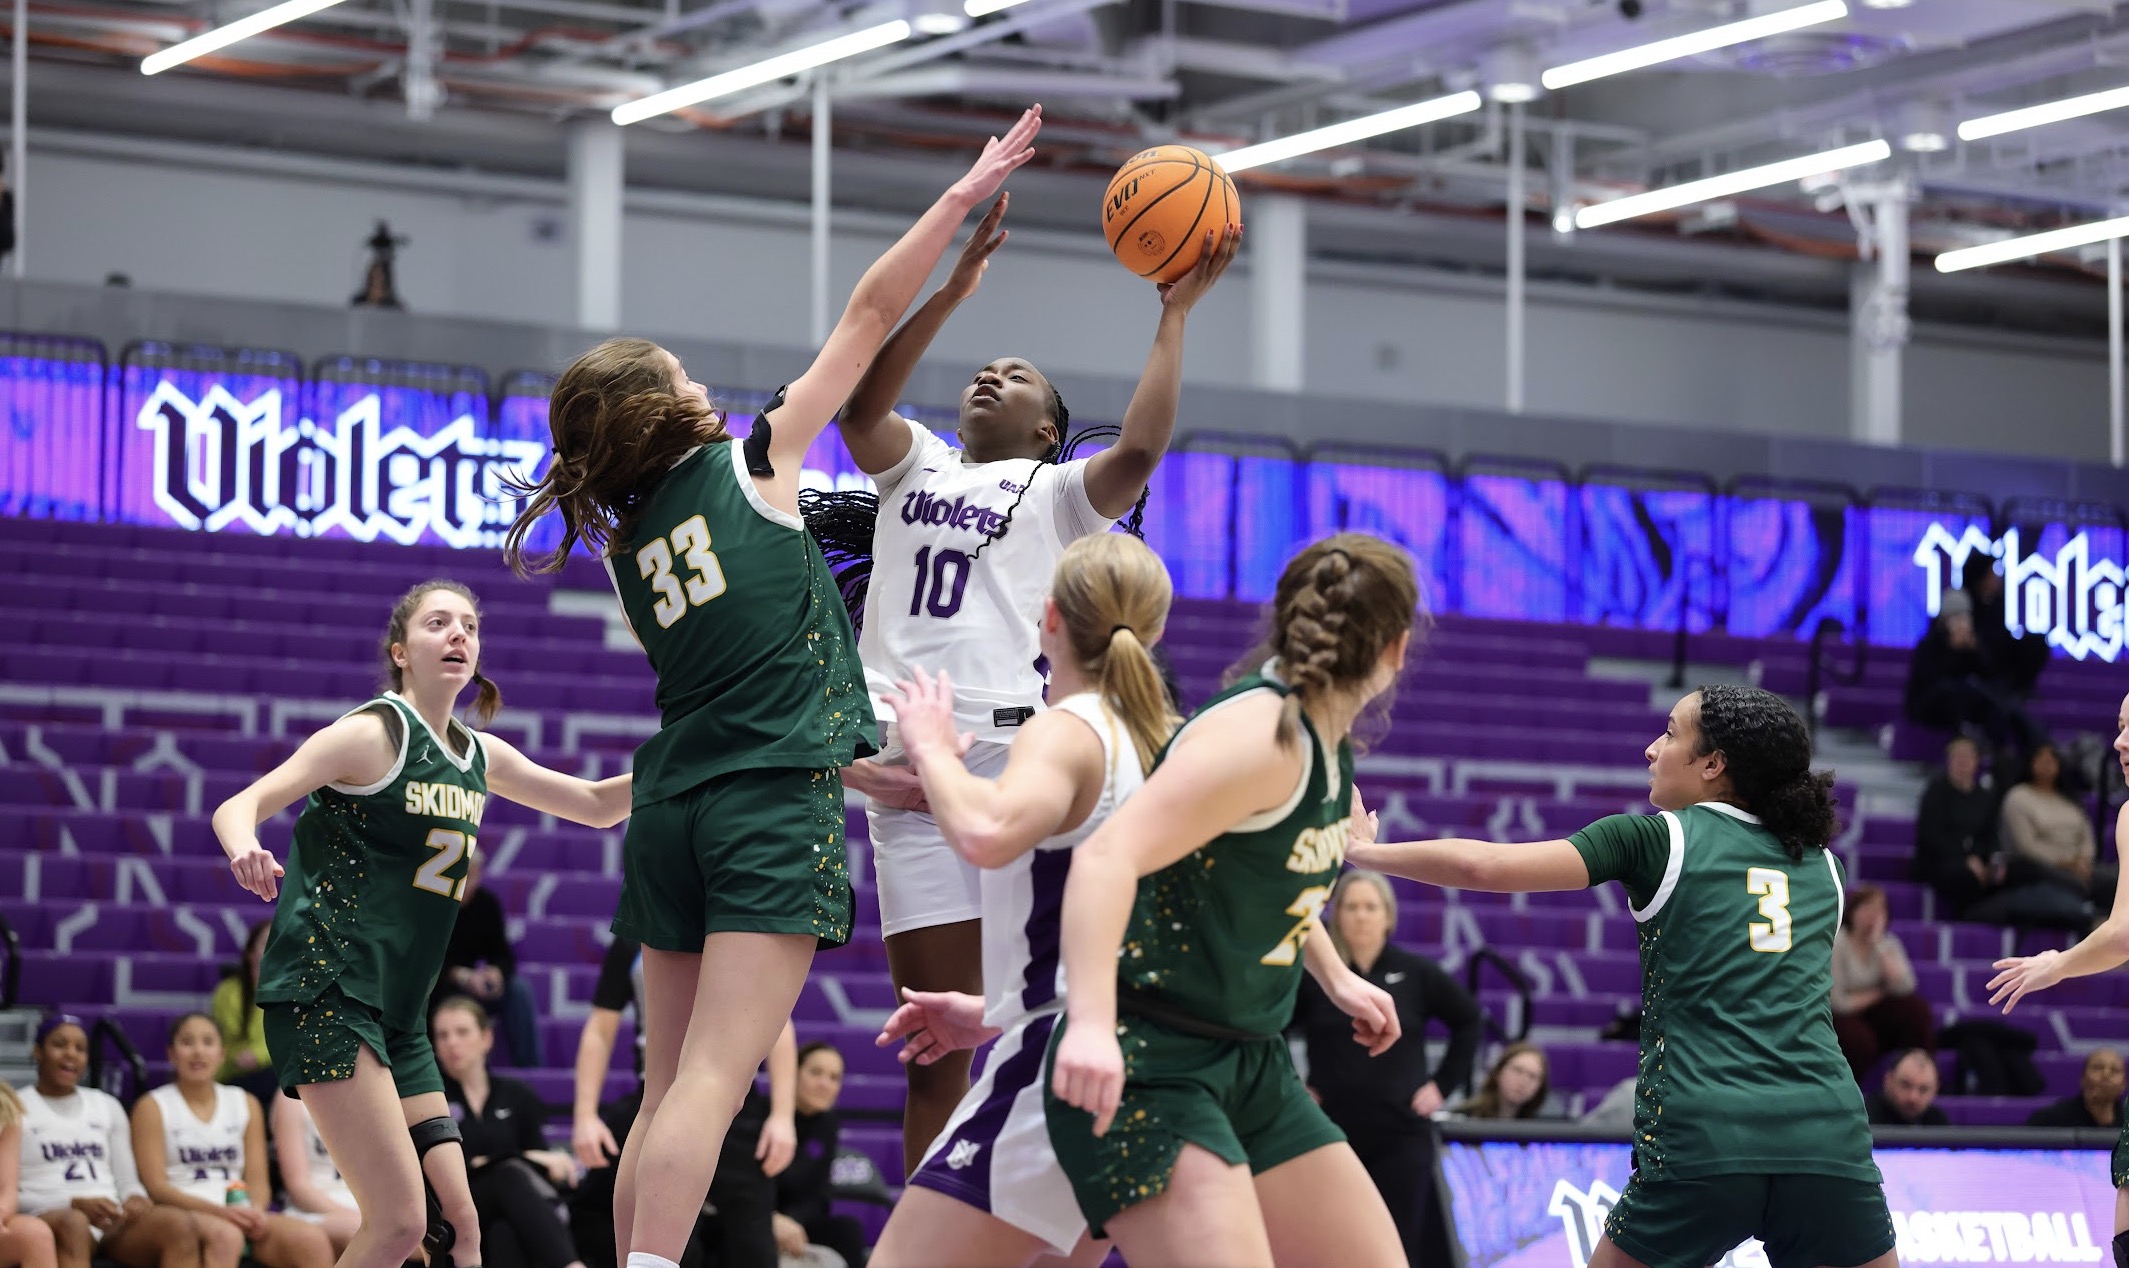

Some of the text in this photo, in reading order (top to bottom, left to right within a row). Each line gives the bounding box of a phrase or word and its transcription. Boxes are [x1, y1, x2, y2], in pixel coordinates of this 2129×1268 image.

[1106, 177, 1139, 223] EVO
[137, 379, 547, 550] Violets
[900, 488, 1011, 540] Violets
[635, 514, 727, 629] 33
[908, 544, 972, 620] 10
[1747, 867, 1792, 953] 3
[64, 1160, 99, 1182] 21
